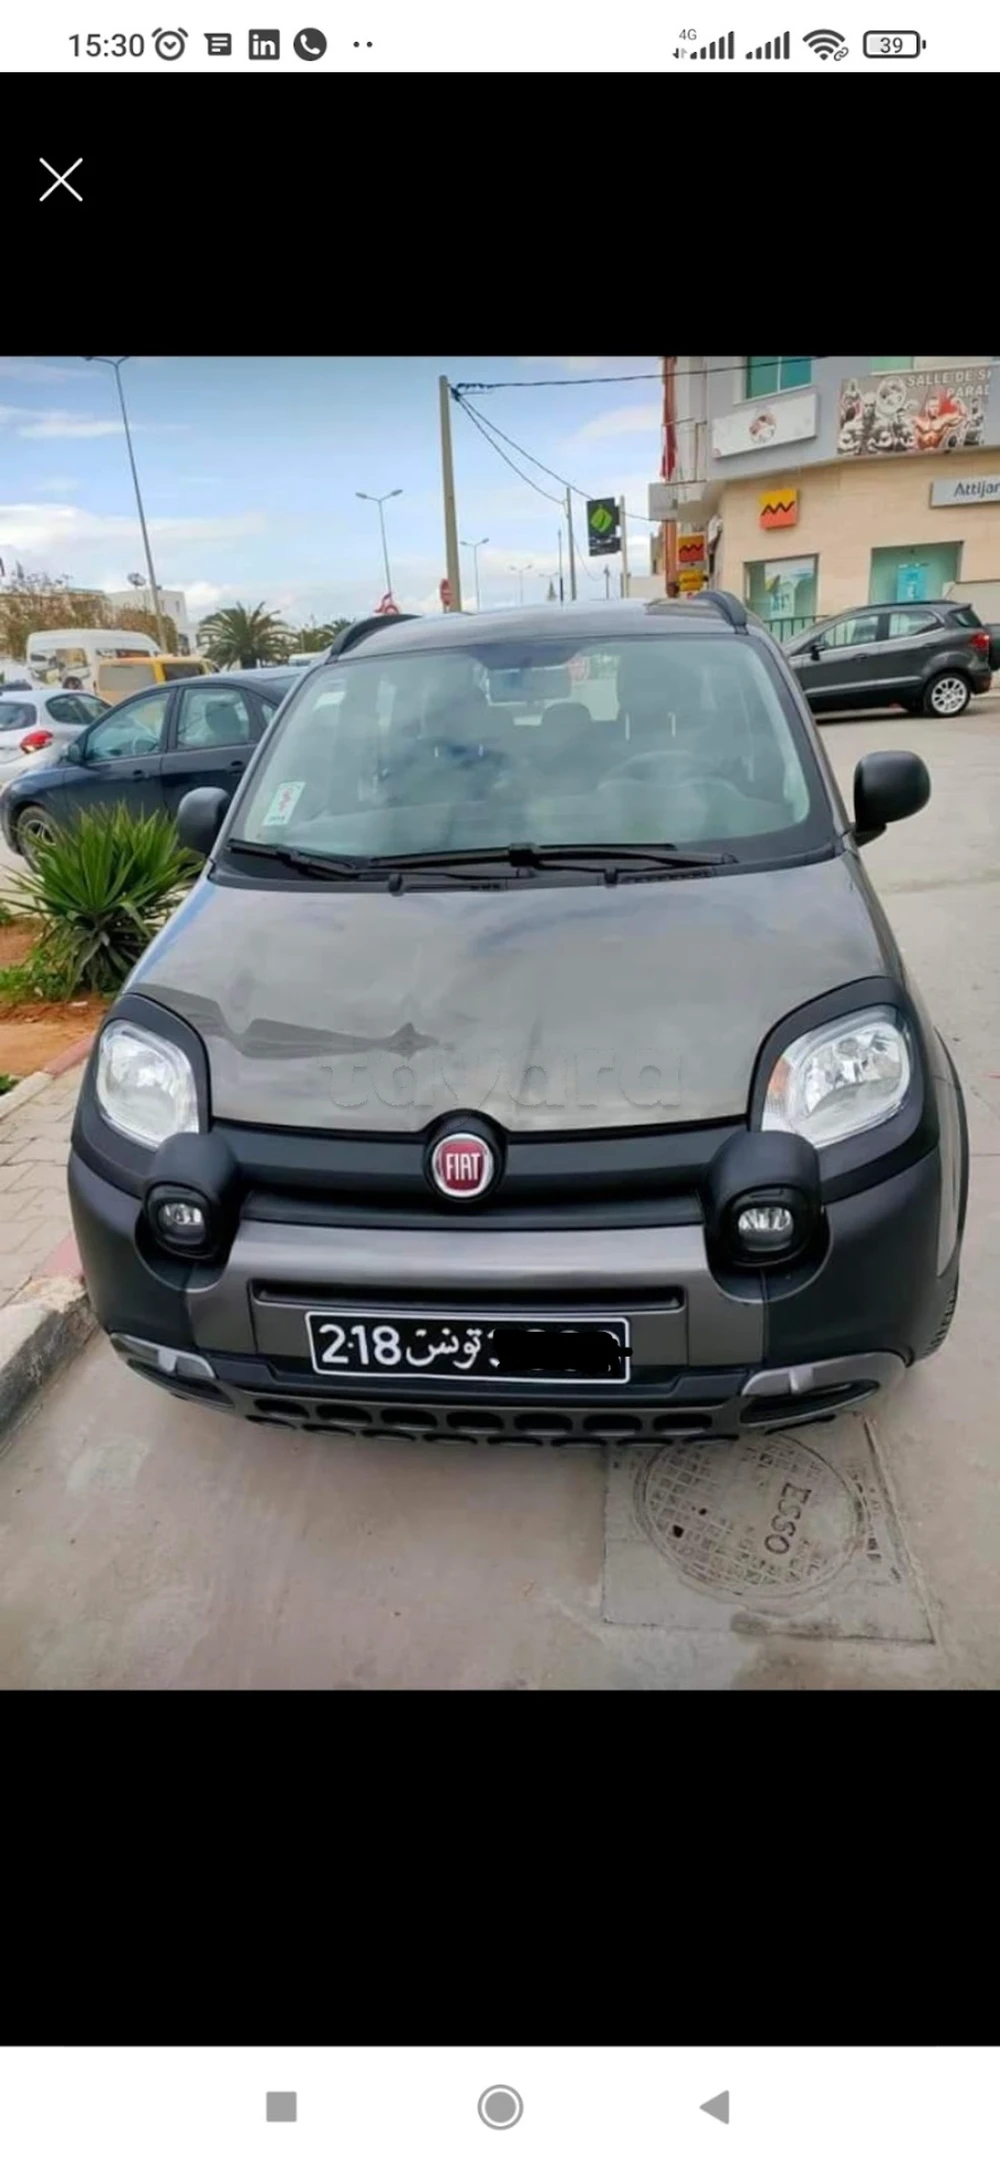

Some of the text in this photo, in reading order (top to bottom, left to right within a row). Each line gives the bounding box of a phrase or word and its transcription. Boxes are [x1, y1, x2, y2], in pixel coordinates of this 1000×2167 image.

[906, 372, 952, 388] SALLE
[955, 370, 973, 382] DE
[446, 1152, 481, 1180] FIAT
[319, 1323, 401, 1366] 218
[405, 1328, 483, 1369] تونس
[764, 1482, 812, 1554] ESSO
